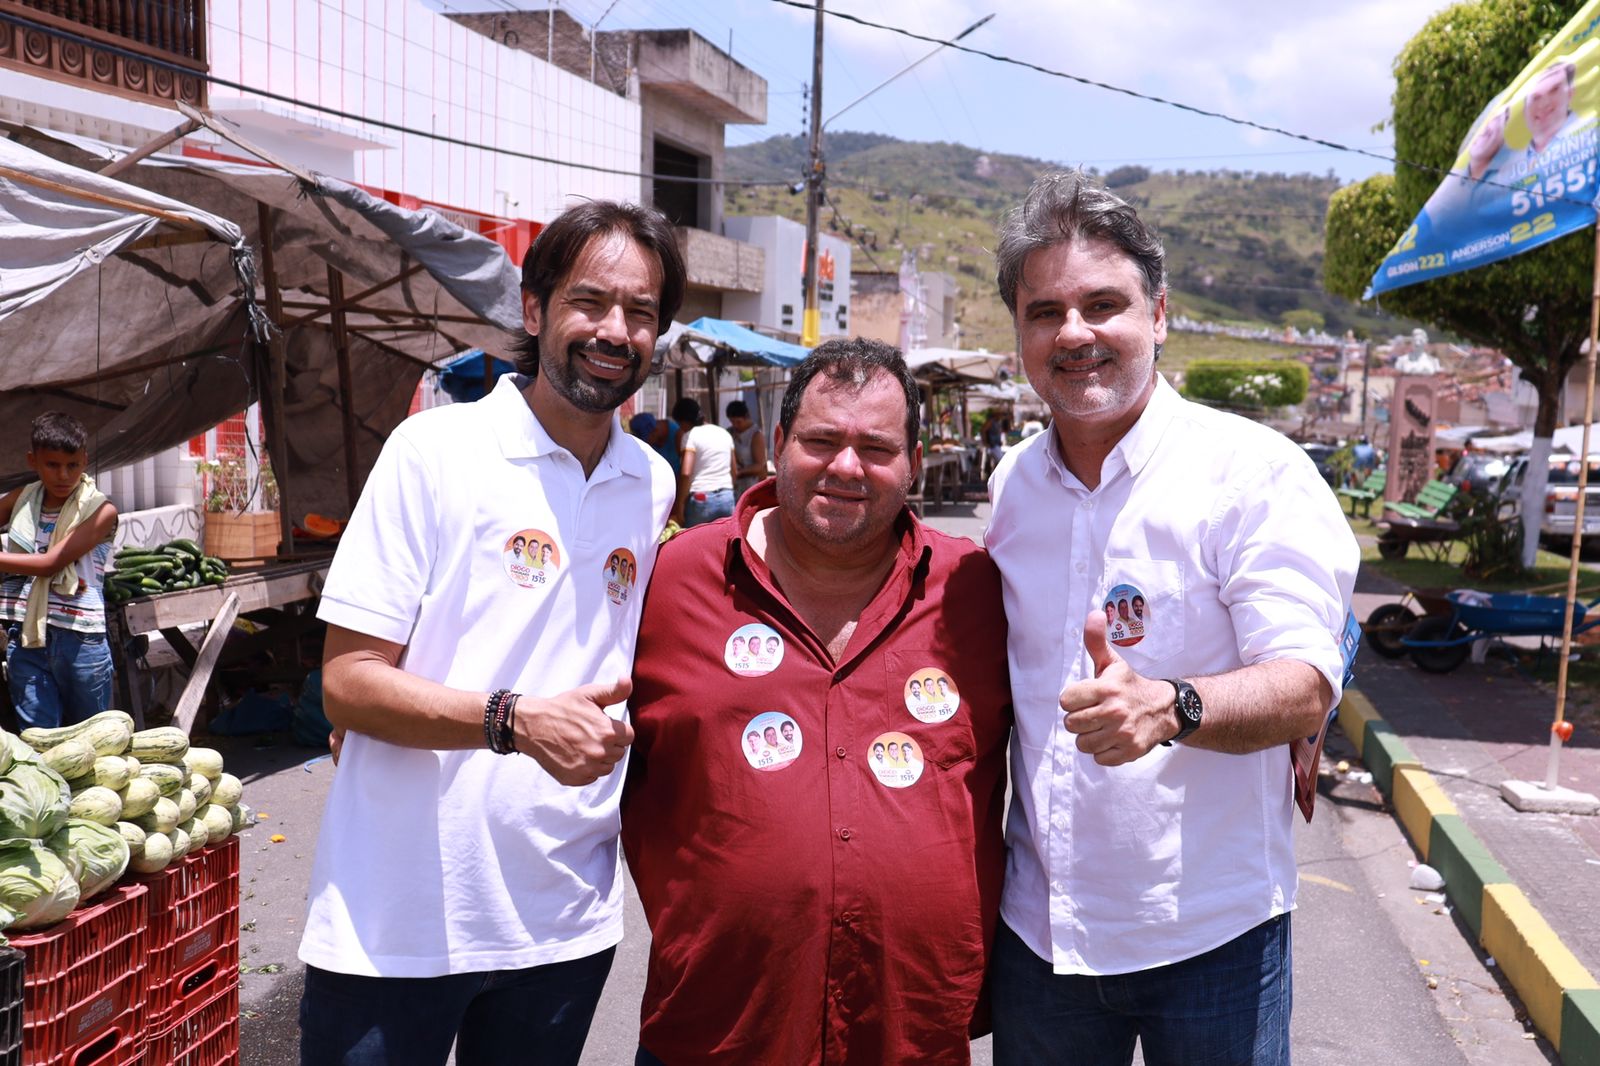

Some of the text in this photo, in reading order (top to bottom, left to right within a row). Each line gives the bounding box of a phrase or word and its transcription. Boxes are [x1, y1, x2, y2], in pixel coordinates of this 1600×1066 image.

[1452, 231, 1510, 259] ANDERSON
[1510, 212, 1556, 244] 22
[1418, 253, 1445, 270] 222
[531, 574, 546, 584] 1515
[1111, 630, 1125, 639] 1515
[938, 708, 953, 716] 1515
[758, 756, 774, 766] 1515
